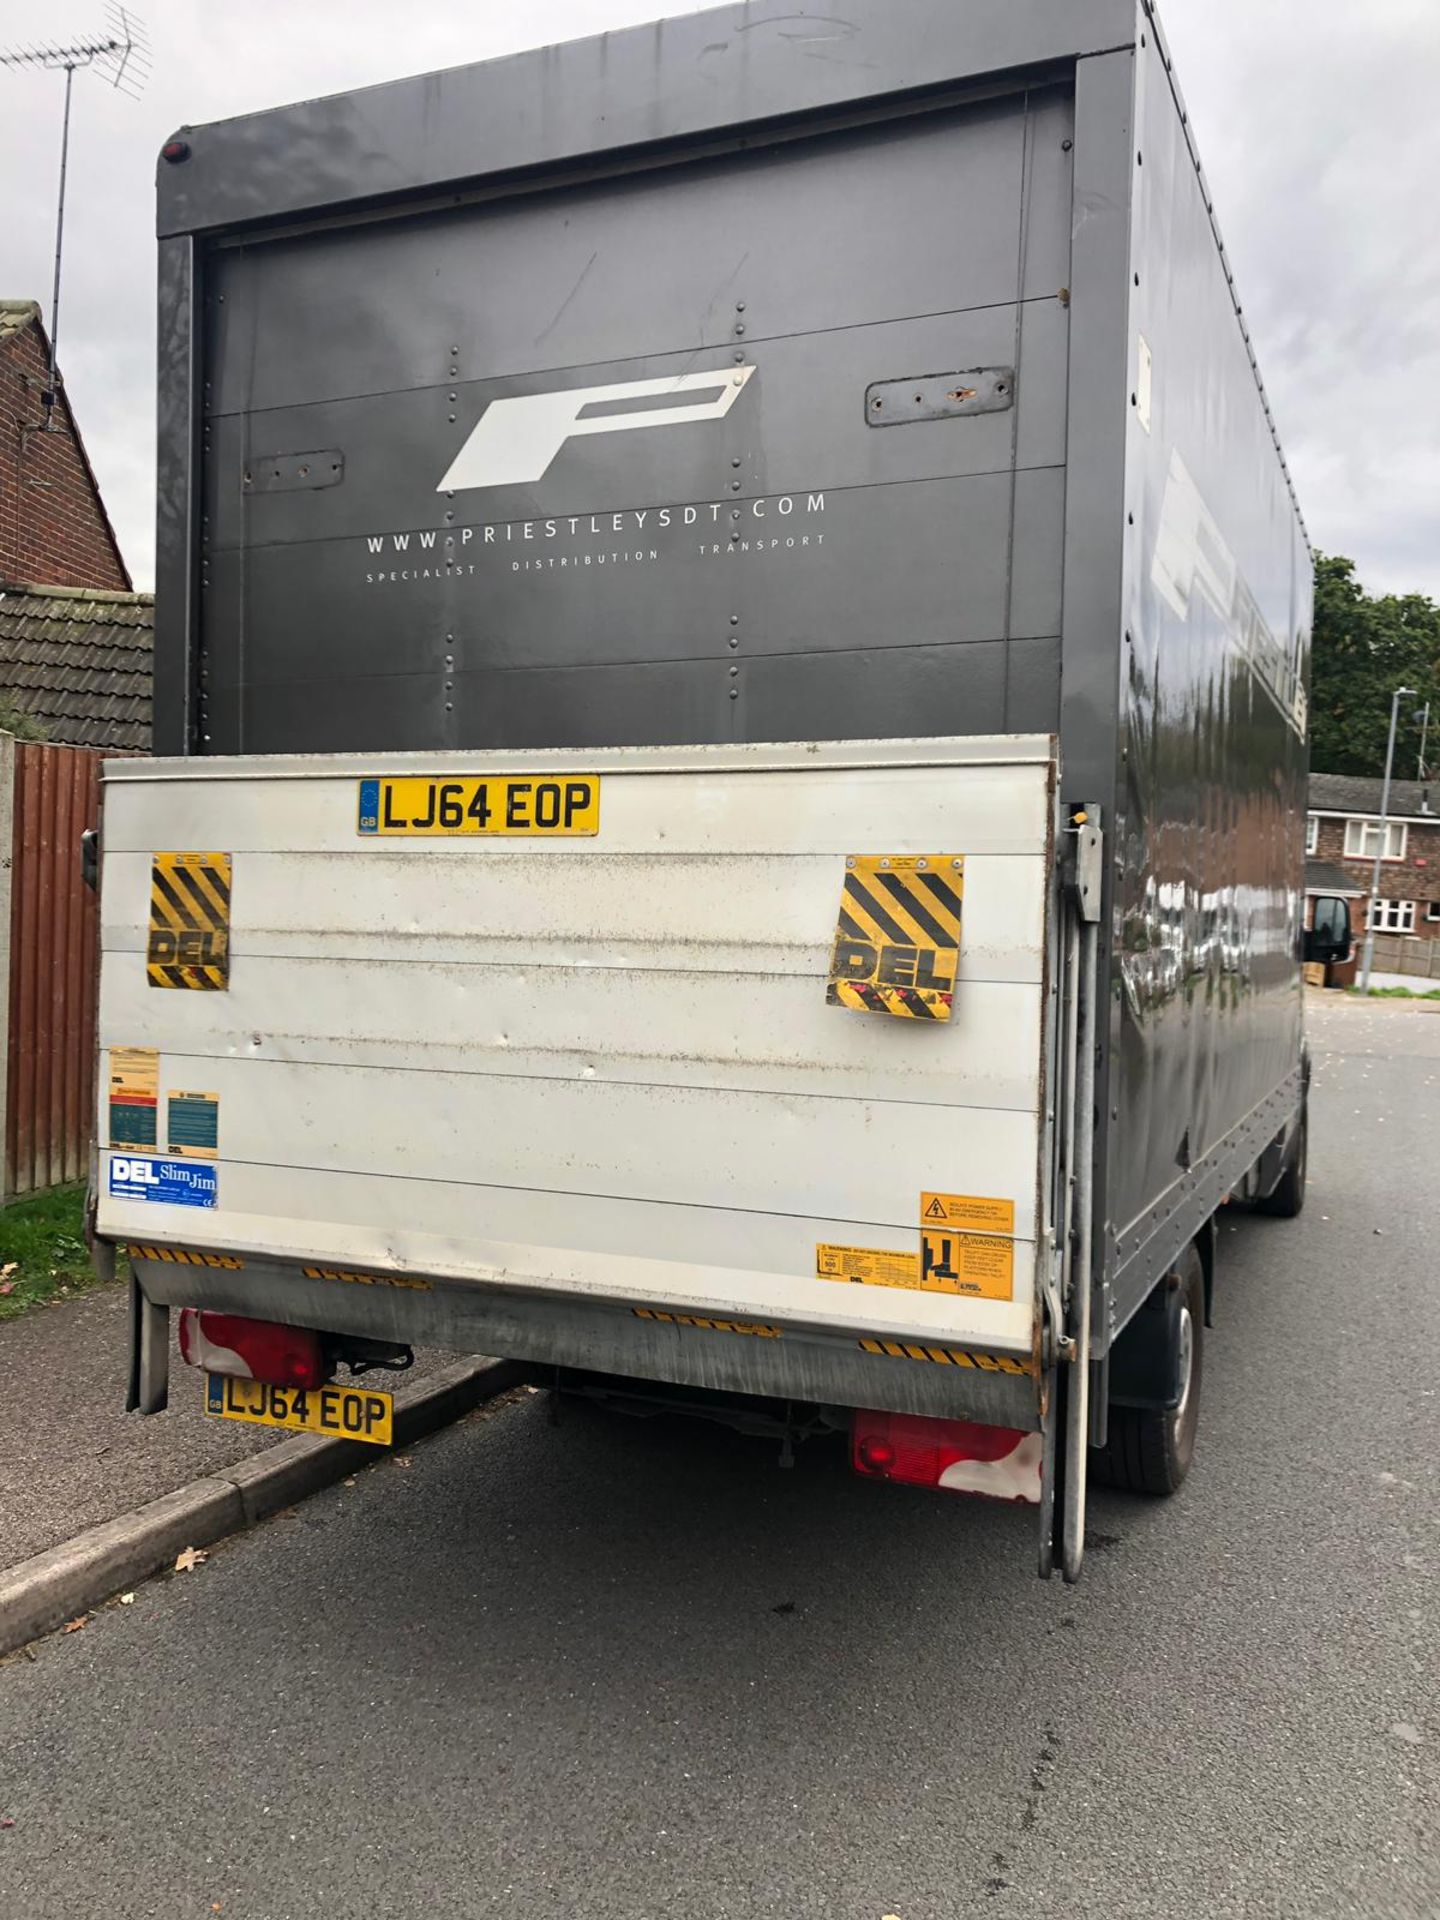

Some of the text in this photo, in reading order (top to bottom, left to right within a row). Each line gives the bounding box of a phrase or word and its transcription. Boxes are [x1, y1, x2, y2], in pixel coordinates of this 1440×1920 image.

[366, 534, 825, 583] SPECIALIST DISTRIBUTION TRANSPORT
[360, 816, 376, 828] GB
[384, 783, 591, 828] LJ64 EOP
[148, 930, 224, 966] DEL
[833, 939, 952, 991] DEL
[112, 1158, 216, 1190] DEL Slim Jim
[970, 1238, 1011, 1249] WARNING
[209, 1399, 222, 1409] GB
[227, 1378, 386, 1434] LJ64 EOP
